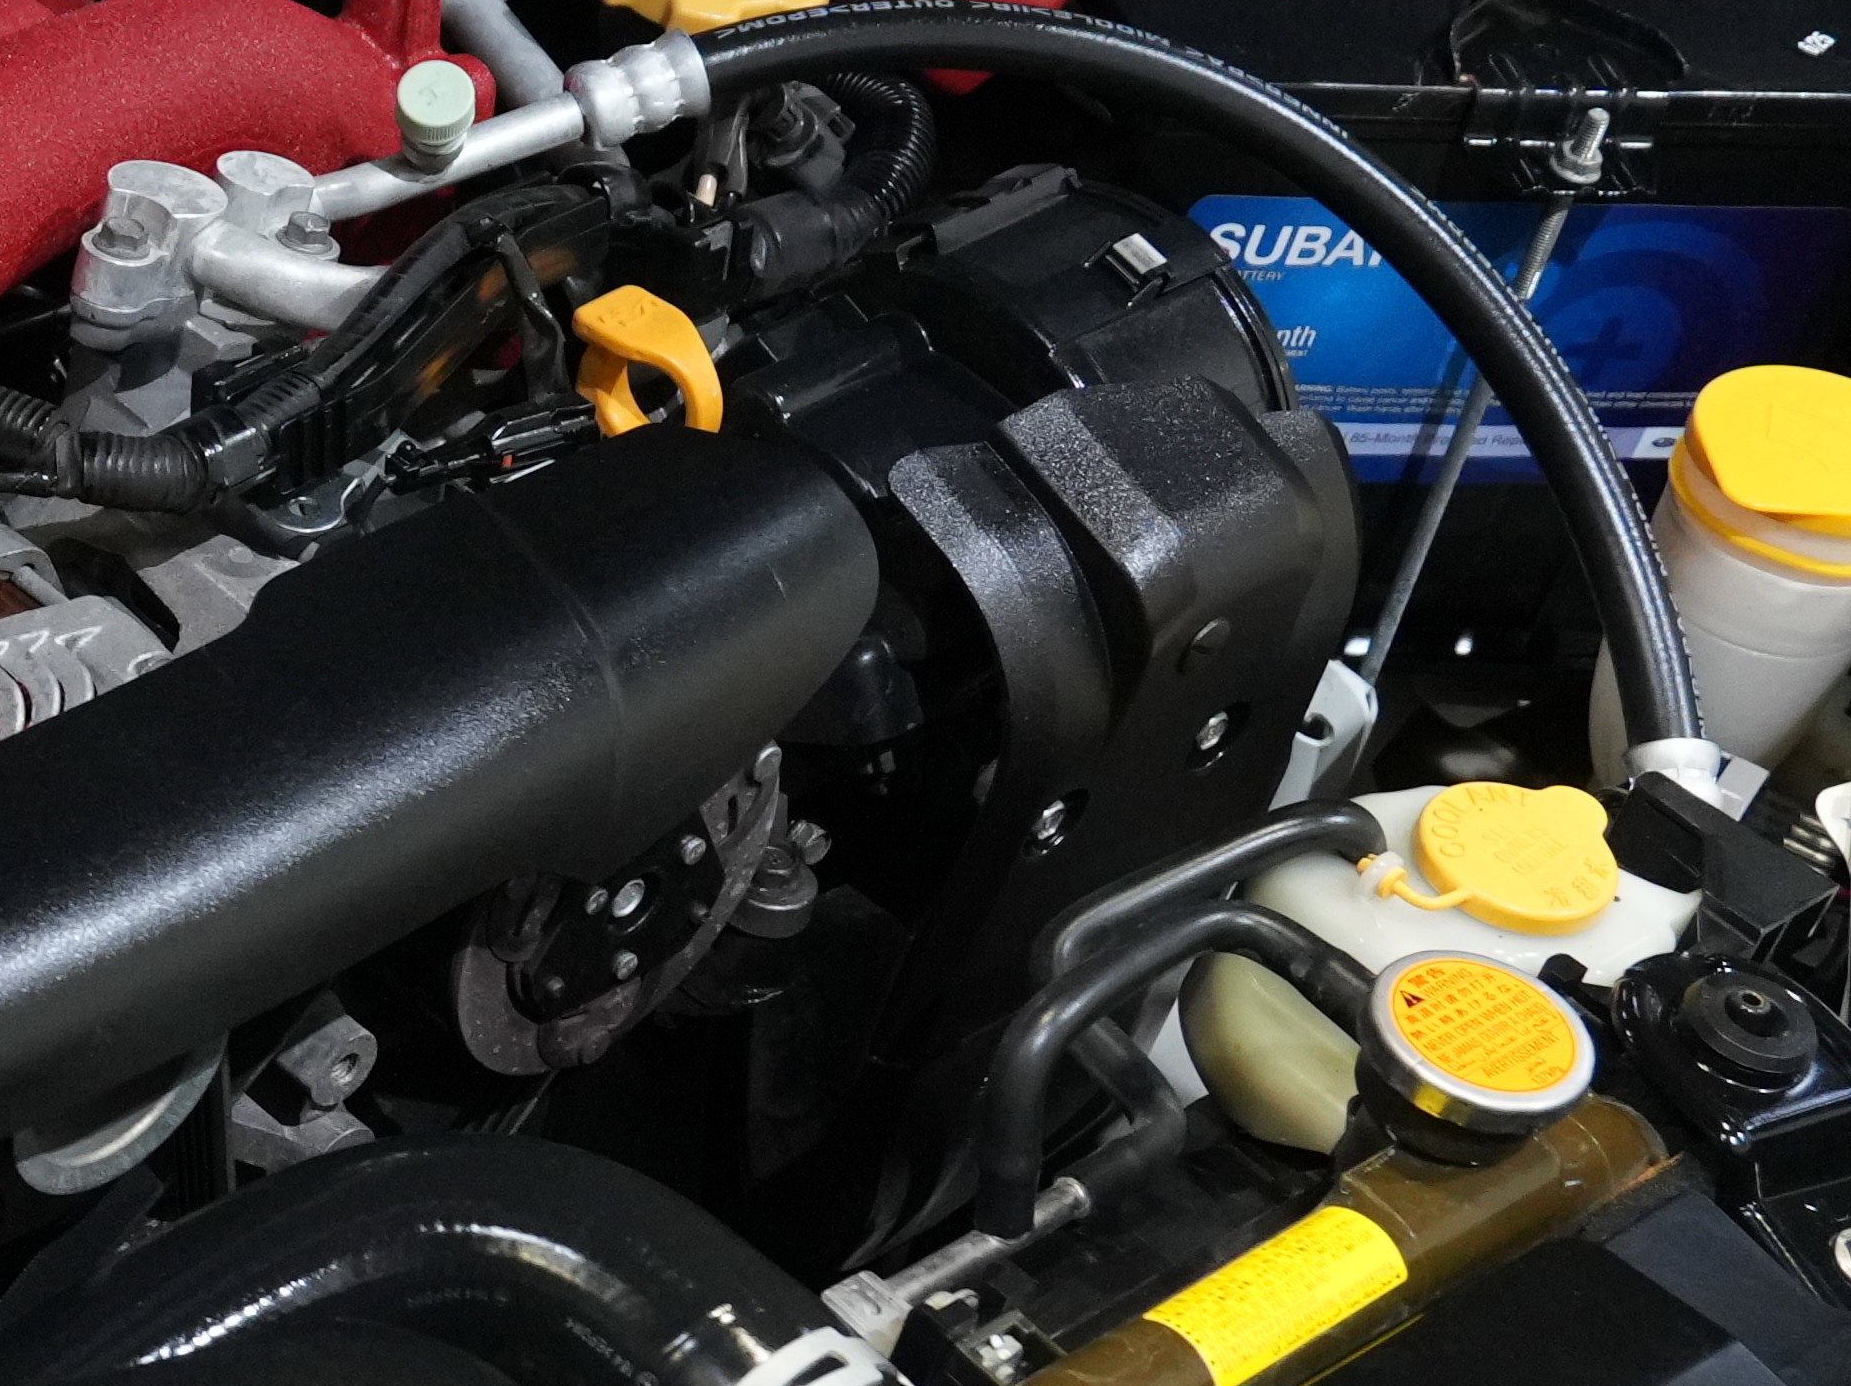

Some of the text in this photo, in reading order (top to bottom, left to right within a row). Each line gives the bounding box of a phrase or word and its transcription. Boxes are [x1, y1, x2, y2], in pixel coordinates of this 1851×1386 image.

[1210, 223, 1383, 267] SUBA
[1276, 325, 1317, 348] nth
[1431, 785, 1532, 858] COOLANT
[1419, 968, 1474, 998] WARNING
[1455, 1016, 1483, 1036] OPEN
[1482, 1003, 1512, 1021] WHEN
[1510, 990, 1531, 1007] HOT
[1482, 1031, 1561, 1079] AVERTISSEMENT
